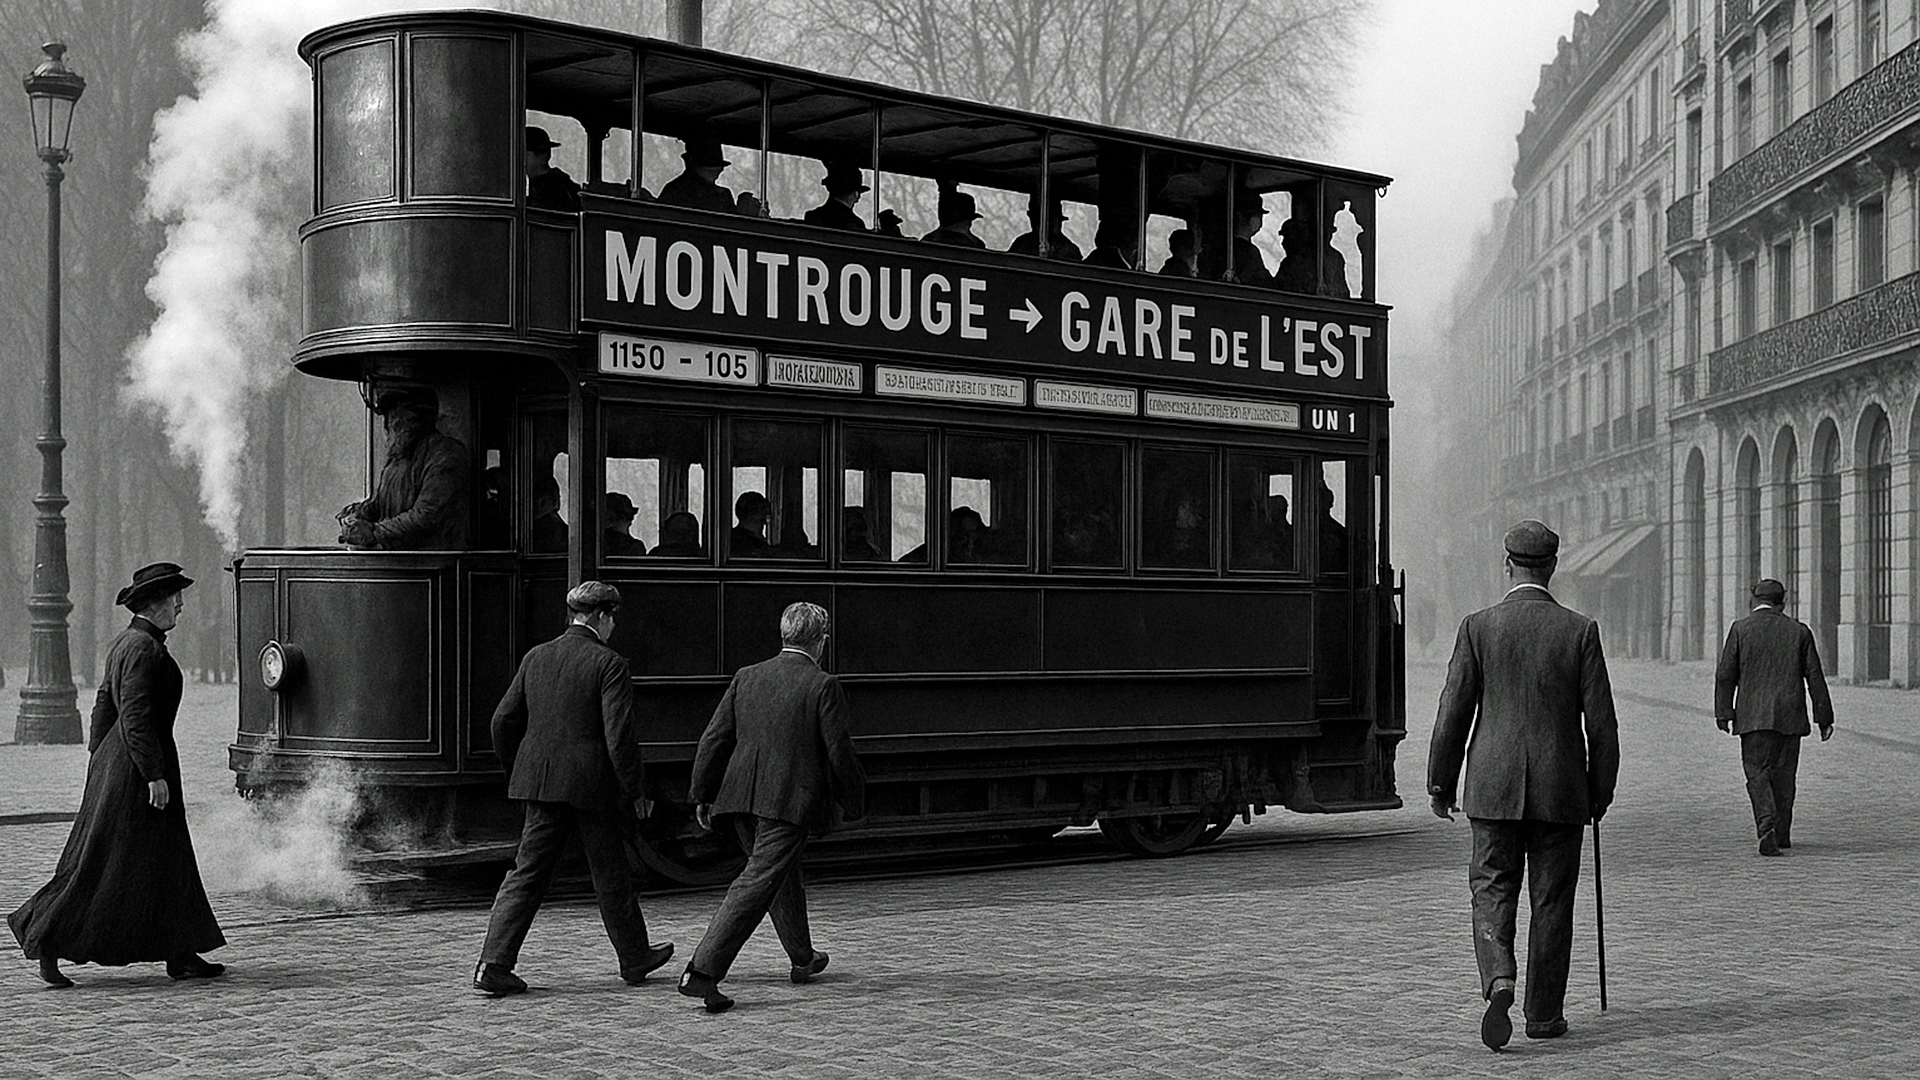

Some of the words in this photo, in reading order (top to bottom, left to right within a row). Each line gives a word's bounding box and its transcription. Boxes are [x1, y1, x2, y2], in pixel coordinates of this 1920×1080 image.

[605, 229, 988, 340] MONTROUGE
[1060, 291, 1196, 362] GARE
[1210, 327, 1249, 368] DE
[1260, 314, 1371, 380] L'EST
[609, 341, 665, 371] 1150
[704, 351, 748, 379] 105
[1311, 408, 1339, 431] UN
[1348, 412, 1356, 433] 1
